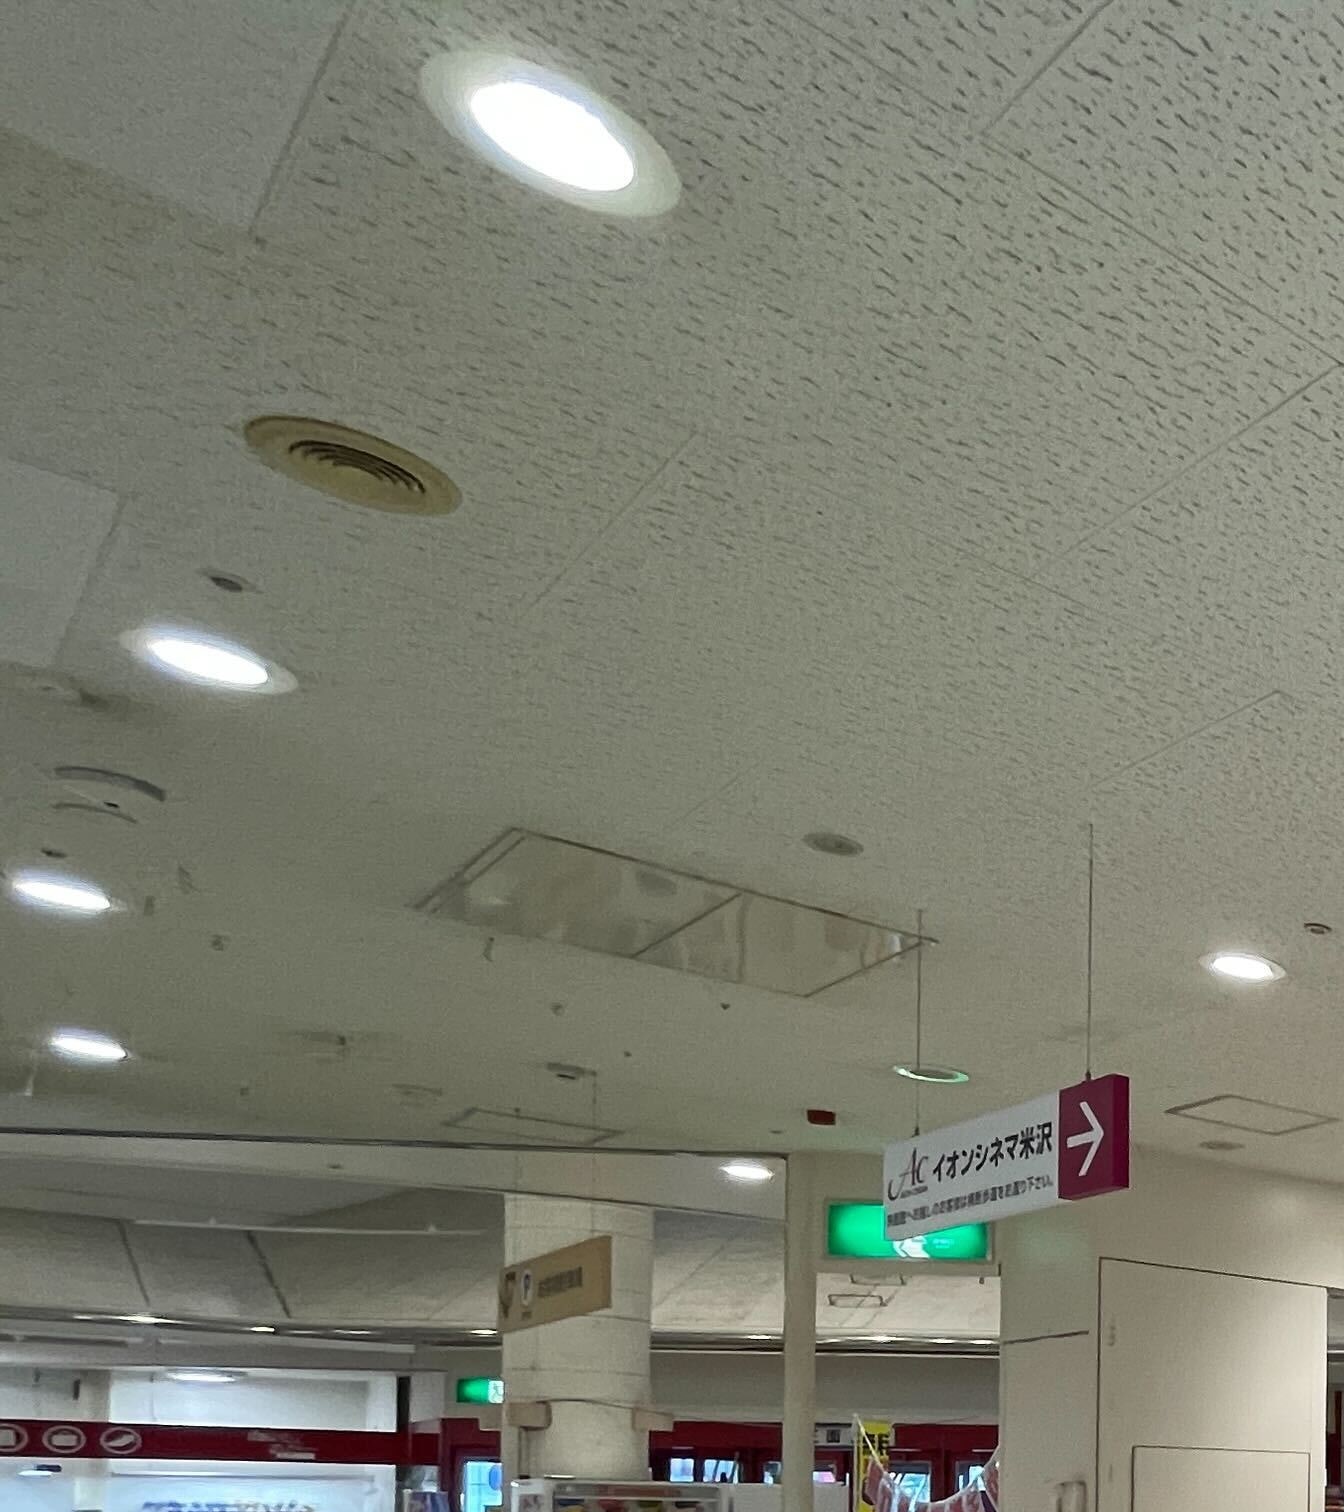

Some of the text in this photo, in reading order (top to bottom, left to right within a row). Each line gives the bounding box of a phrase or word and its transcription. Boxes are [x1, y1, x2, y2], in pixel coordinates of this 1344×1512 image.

[933, 1121, 1052, 1183] イオンシネマ米沢
